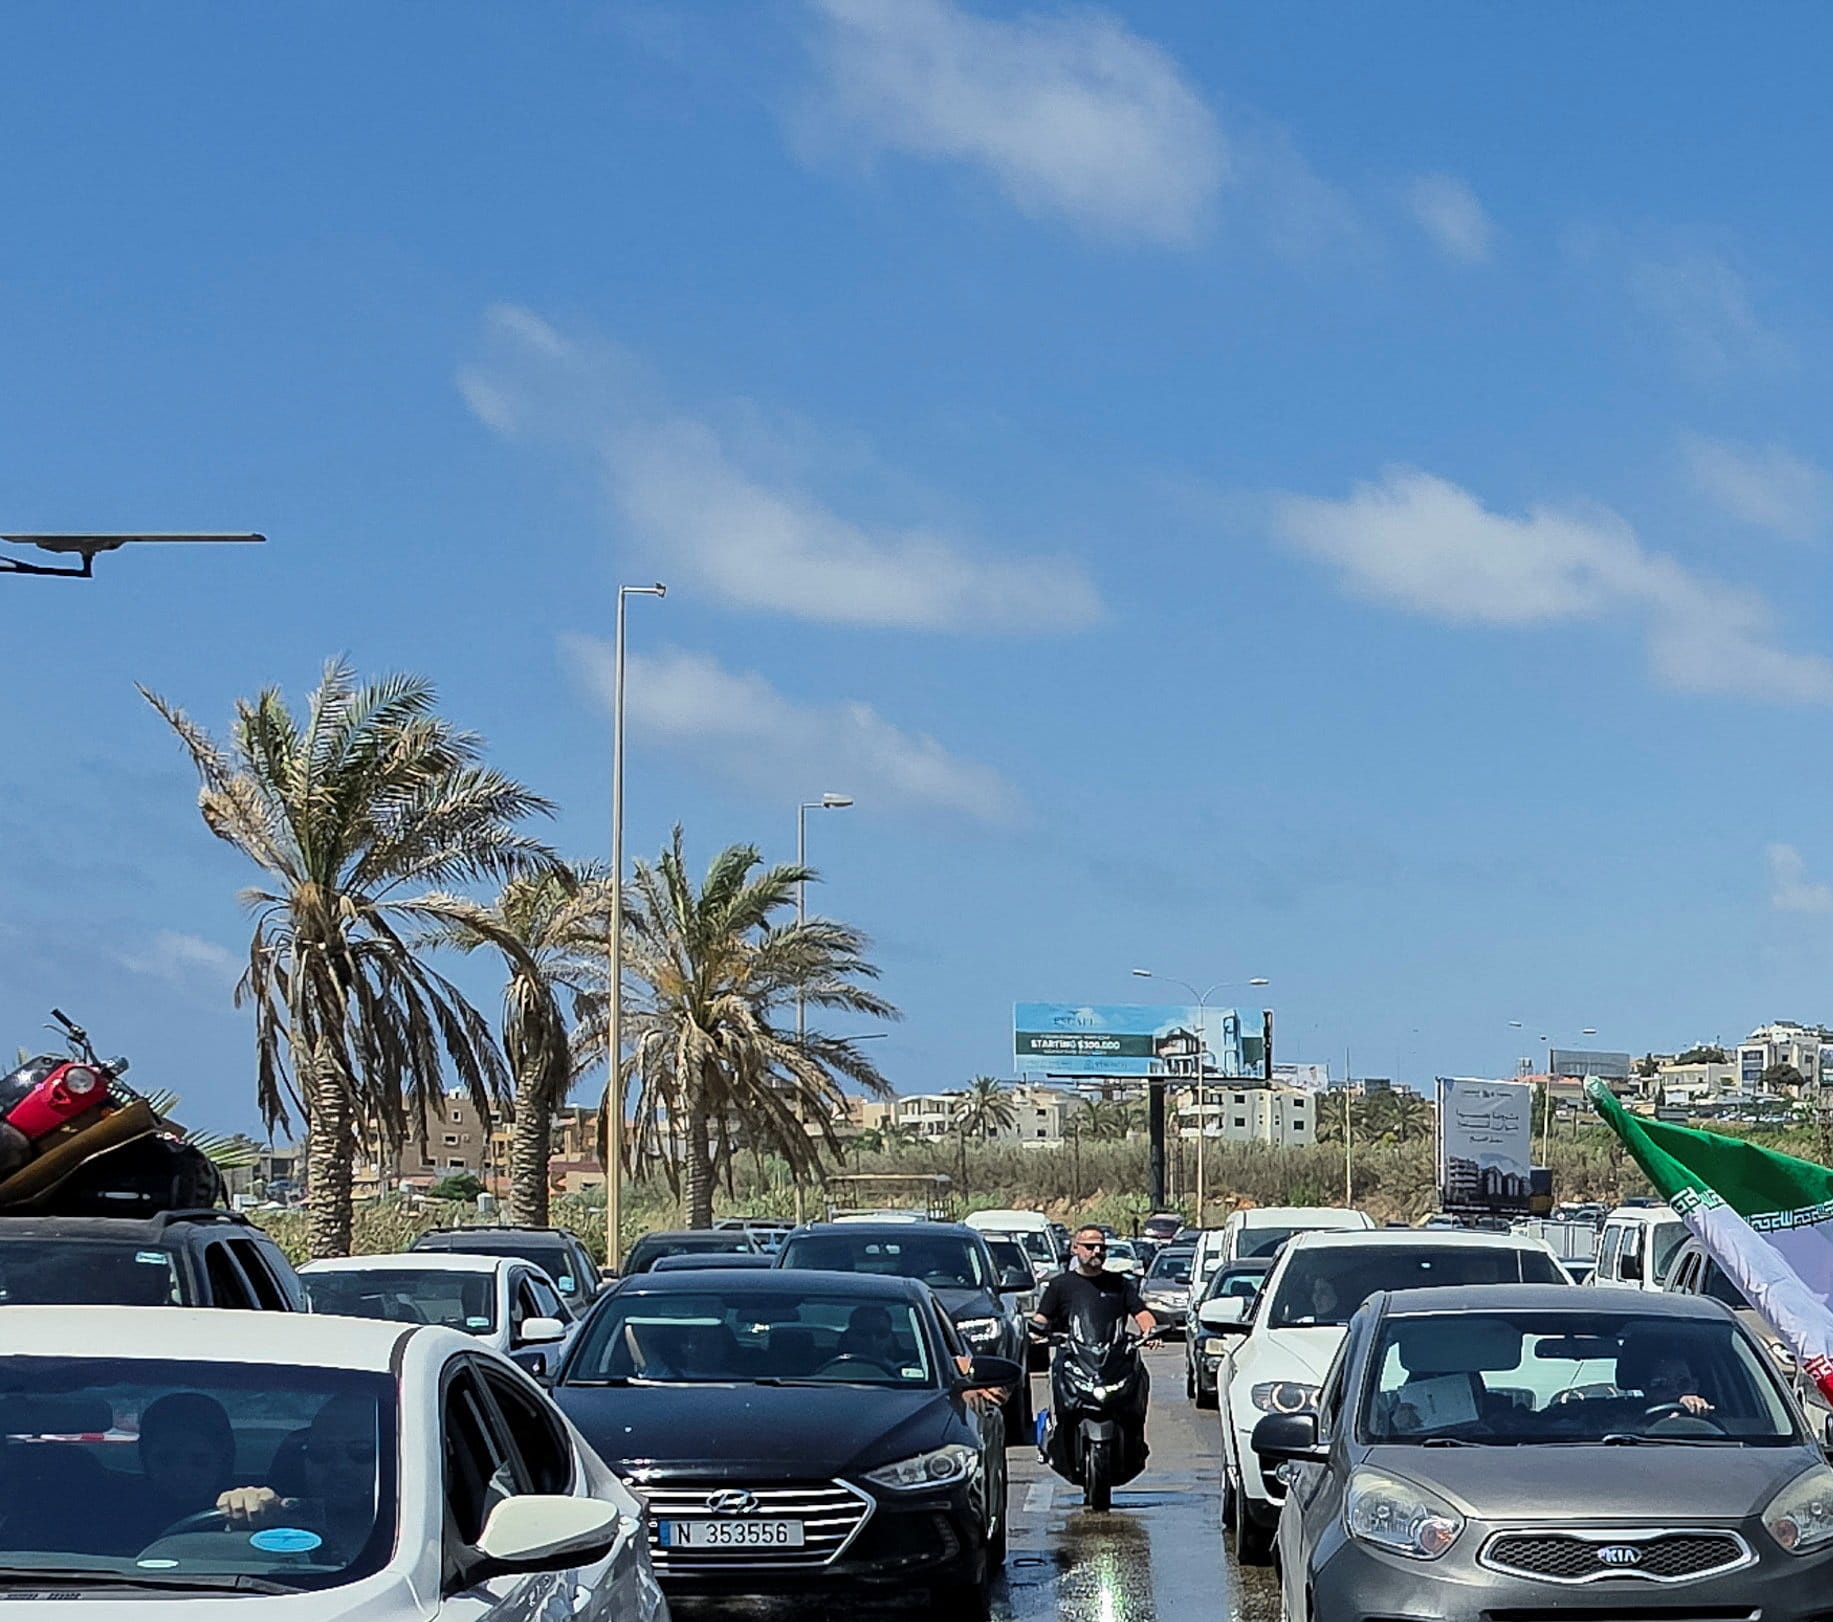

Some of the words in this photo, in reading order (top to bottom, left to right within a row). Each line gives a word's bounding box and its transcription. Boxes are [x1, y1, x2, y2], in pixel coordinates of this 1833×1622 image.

[677, 1523, 691, 1544] N
[706, 1522, 788, 1544] 353556
[1605, 1549, 1637, 1563] KIA
